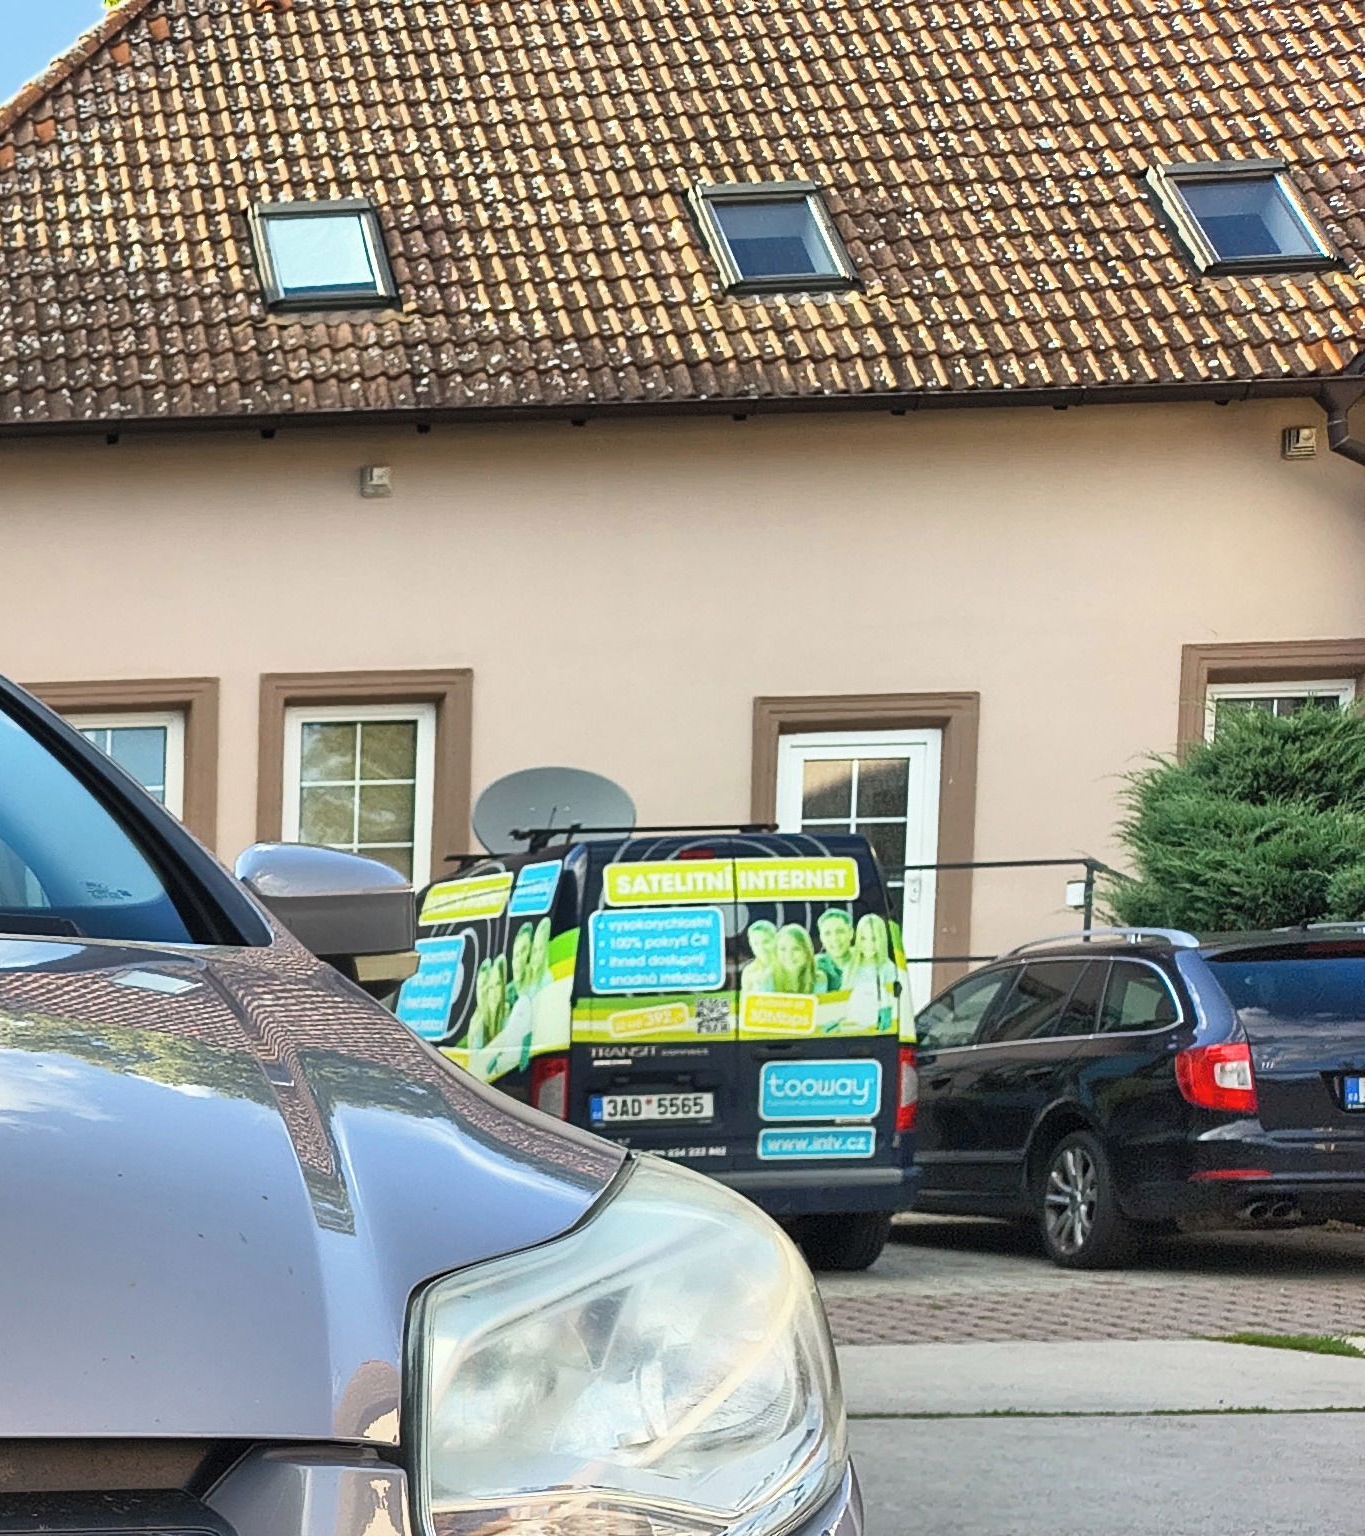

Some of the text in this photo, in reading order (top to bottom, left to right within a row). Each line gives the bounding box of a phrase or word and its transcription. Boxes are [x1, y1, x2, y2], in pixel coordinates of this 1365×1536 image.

[616, 866, 847, 895] SATELITNÍ INTERNET
[590, 1046, 656, 1057] TRANSIT
[769, 1075, 869, 1106] tooway
[607, 1099, 642, 1117] 3AD
[658, 1096, 704, 1115] 5565
